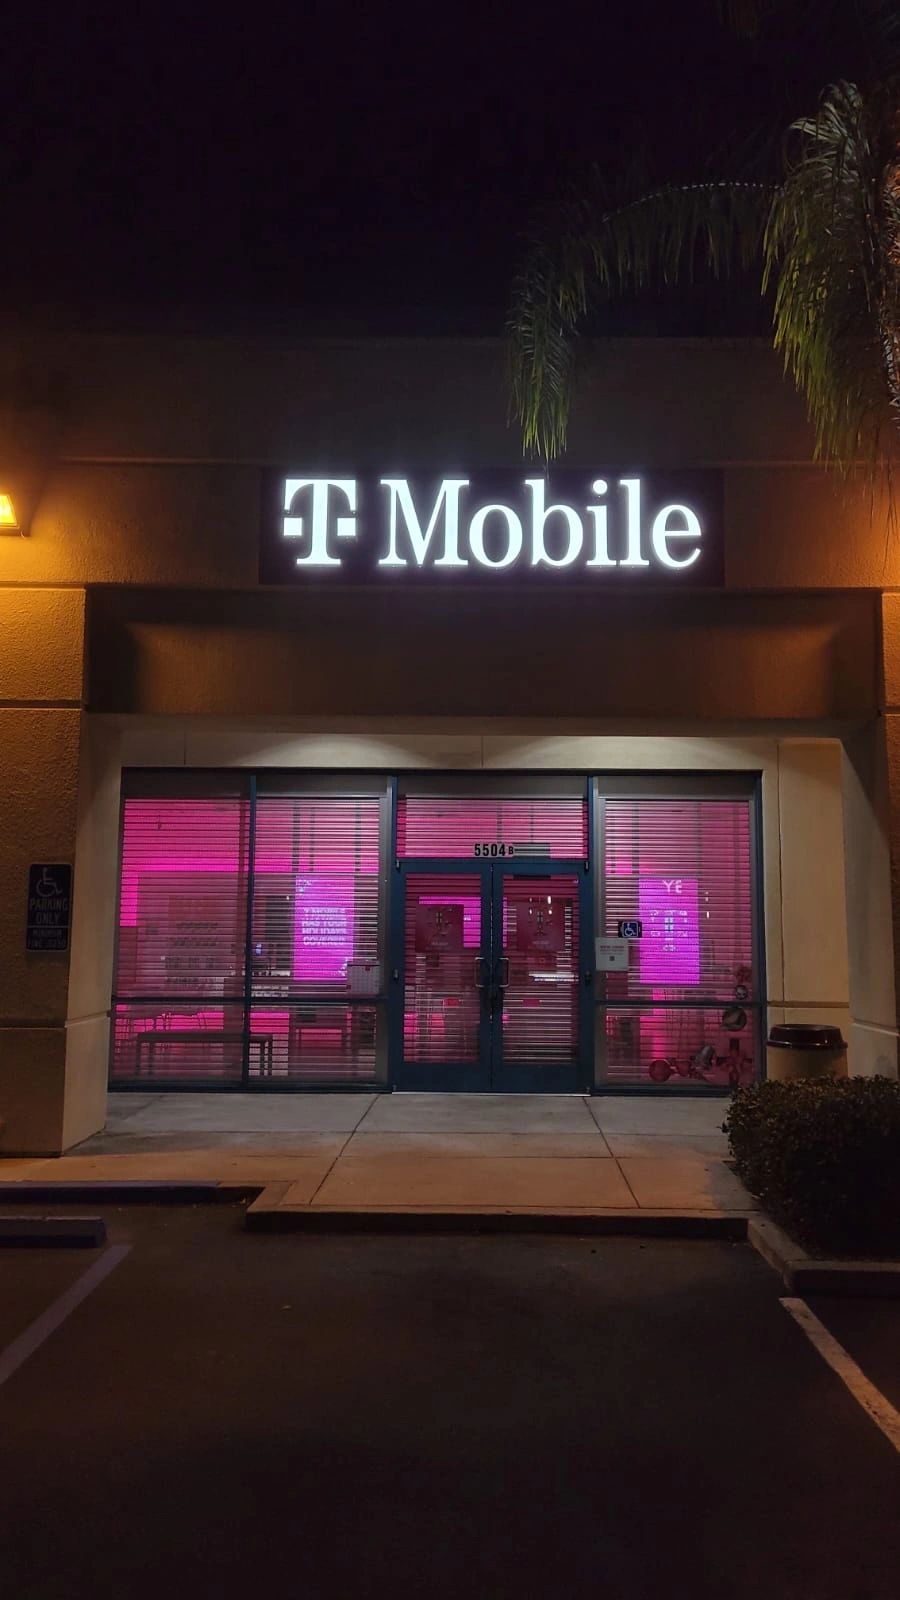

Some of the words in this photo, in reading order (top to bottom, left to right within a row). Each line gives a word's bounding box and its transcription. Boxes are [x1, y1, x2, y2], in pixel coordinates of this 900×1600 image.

[378, 478, 702, 569] Mobile
[30, 898, 69, 911] PARKING
[36, 912, 60, 924] ONLY
